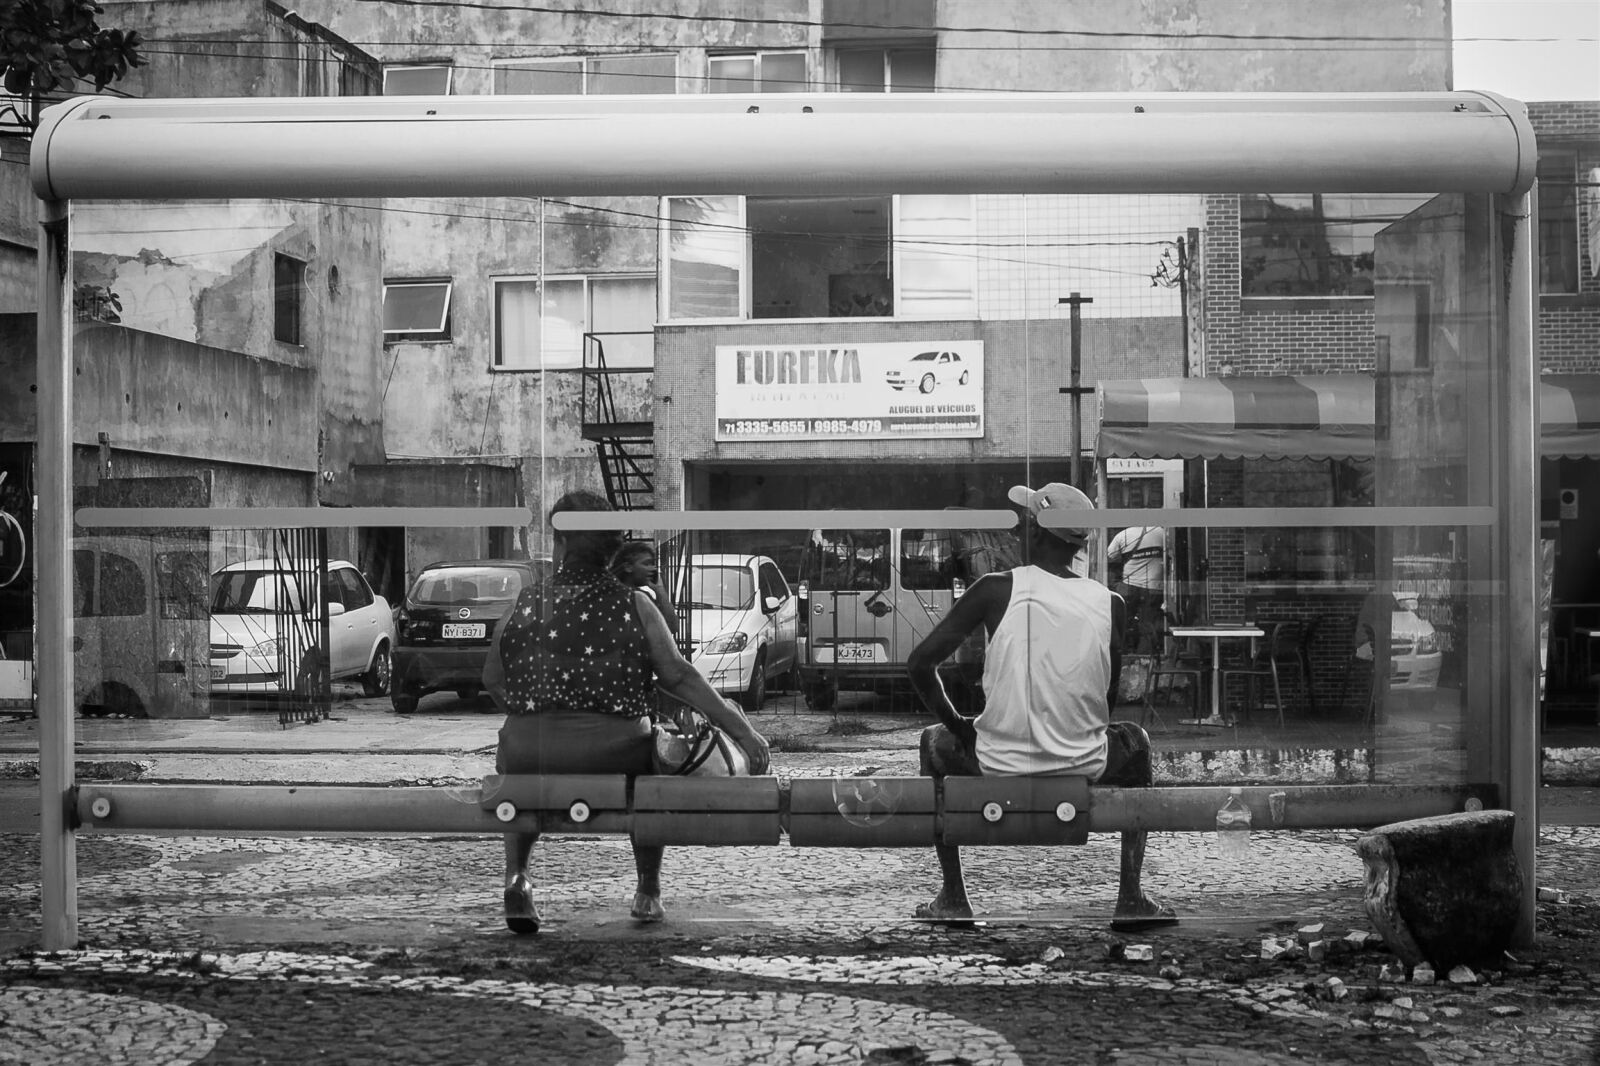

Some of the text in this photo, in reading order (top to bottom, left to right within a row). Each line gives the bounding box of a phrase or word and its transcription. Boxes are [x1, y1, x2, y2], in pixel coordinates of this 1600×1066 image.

[889, 403, 976, 414] ALUGUEL DE VEÍCULOS
[725, 420, 882, 433] 71 3335-5655 9985-4979
[444, 628, 482, 637] NYI-8371
[835, 649, 873, 658] KJ-7473
